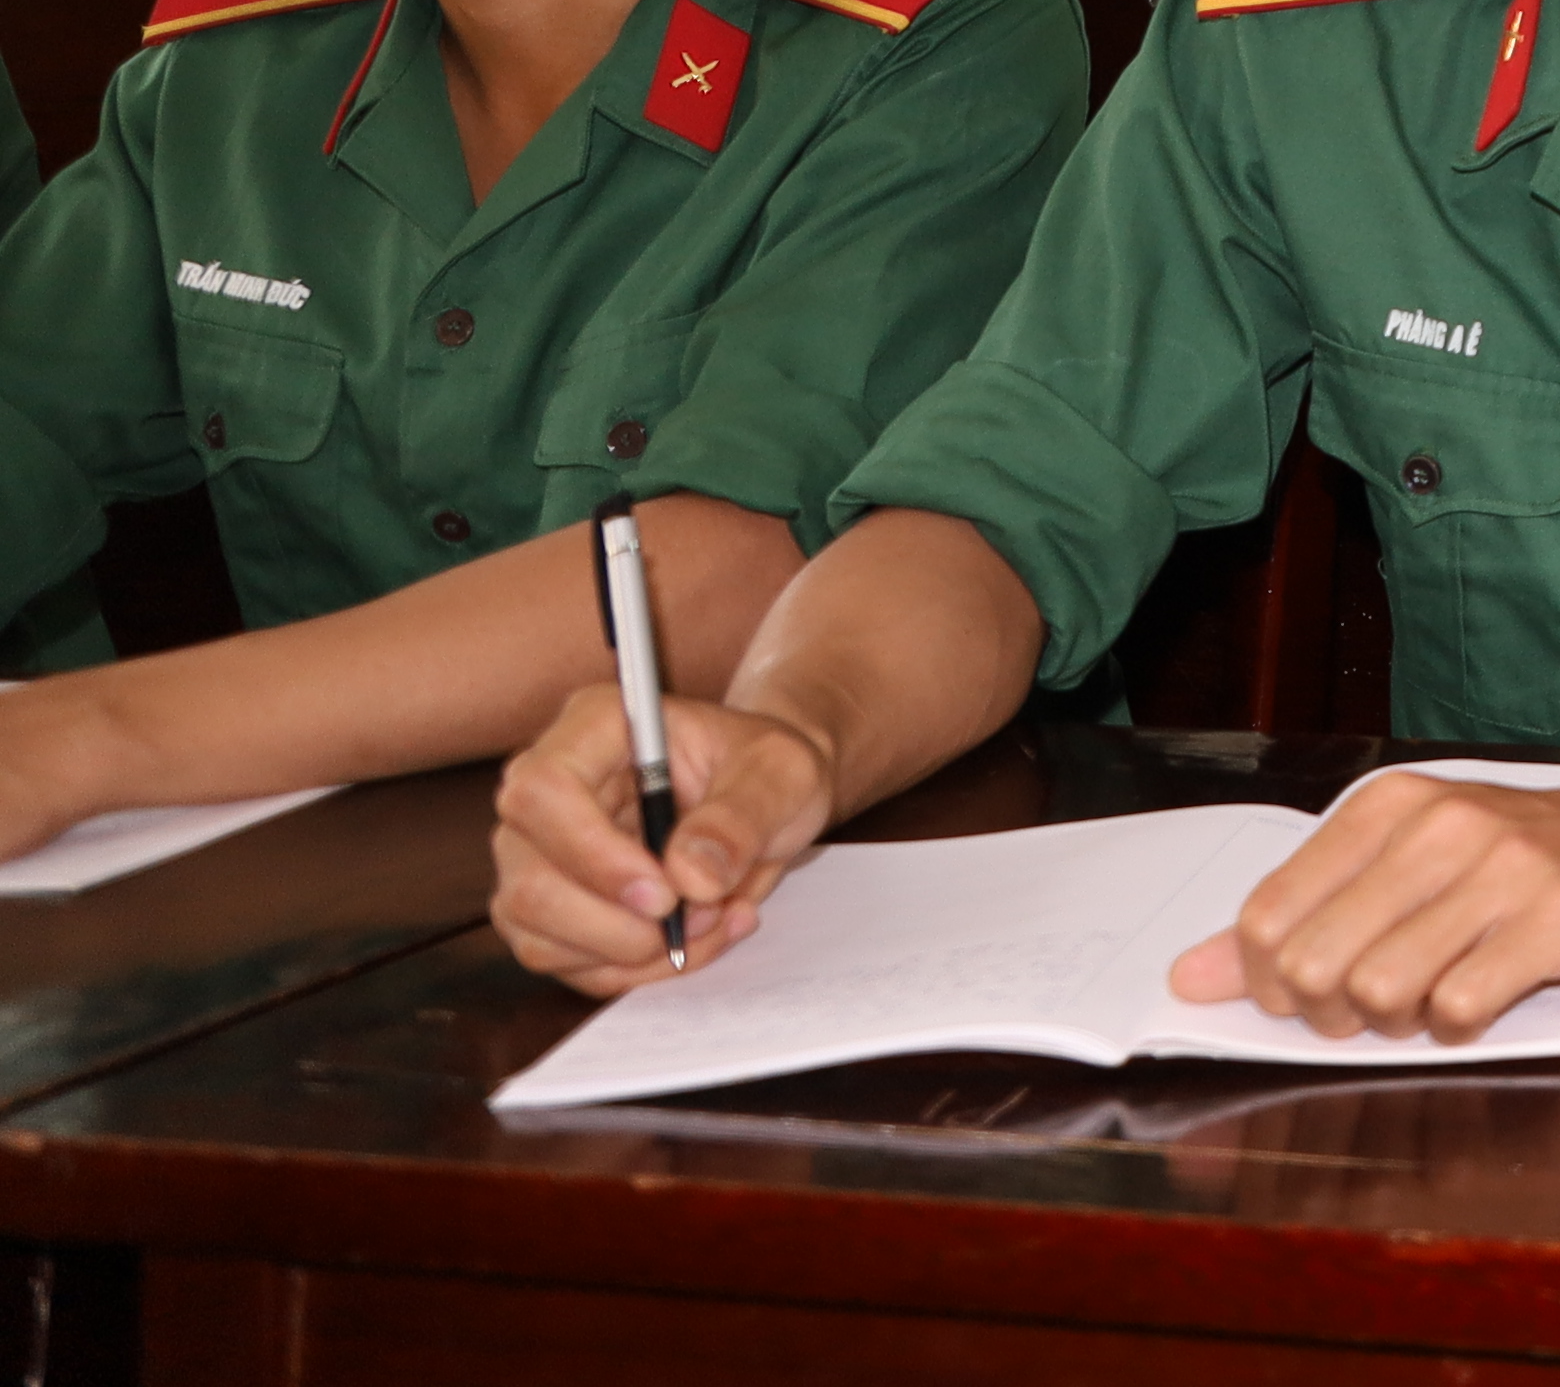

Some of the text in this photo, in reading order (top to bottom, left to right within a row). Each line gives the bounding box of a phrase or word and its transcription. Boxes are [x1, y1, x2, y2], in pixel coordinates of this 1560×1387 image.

[222, 271, 269, 304] MINH
[264, 278, 312, 310] ĐỨC
[1447, 324, 1464, 354] A
